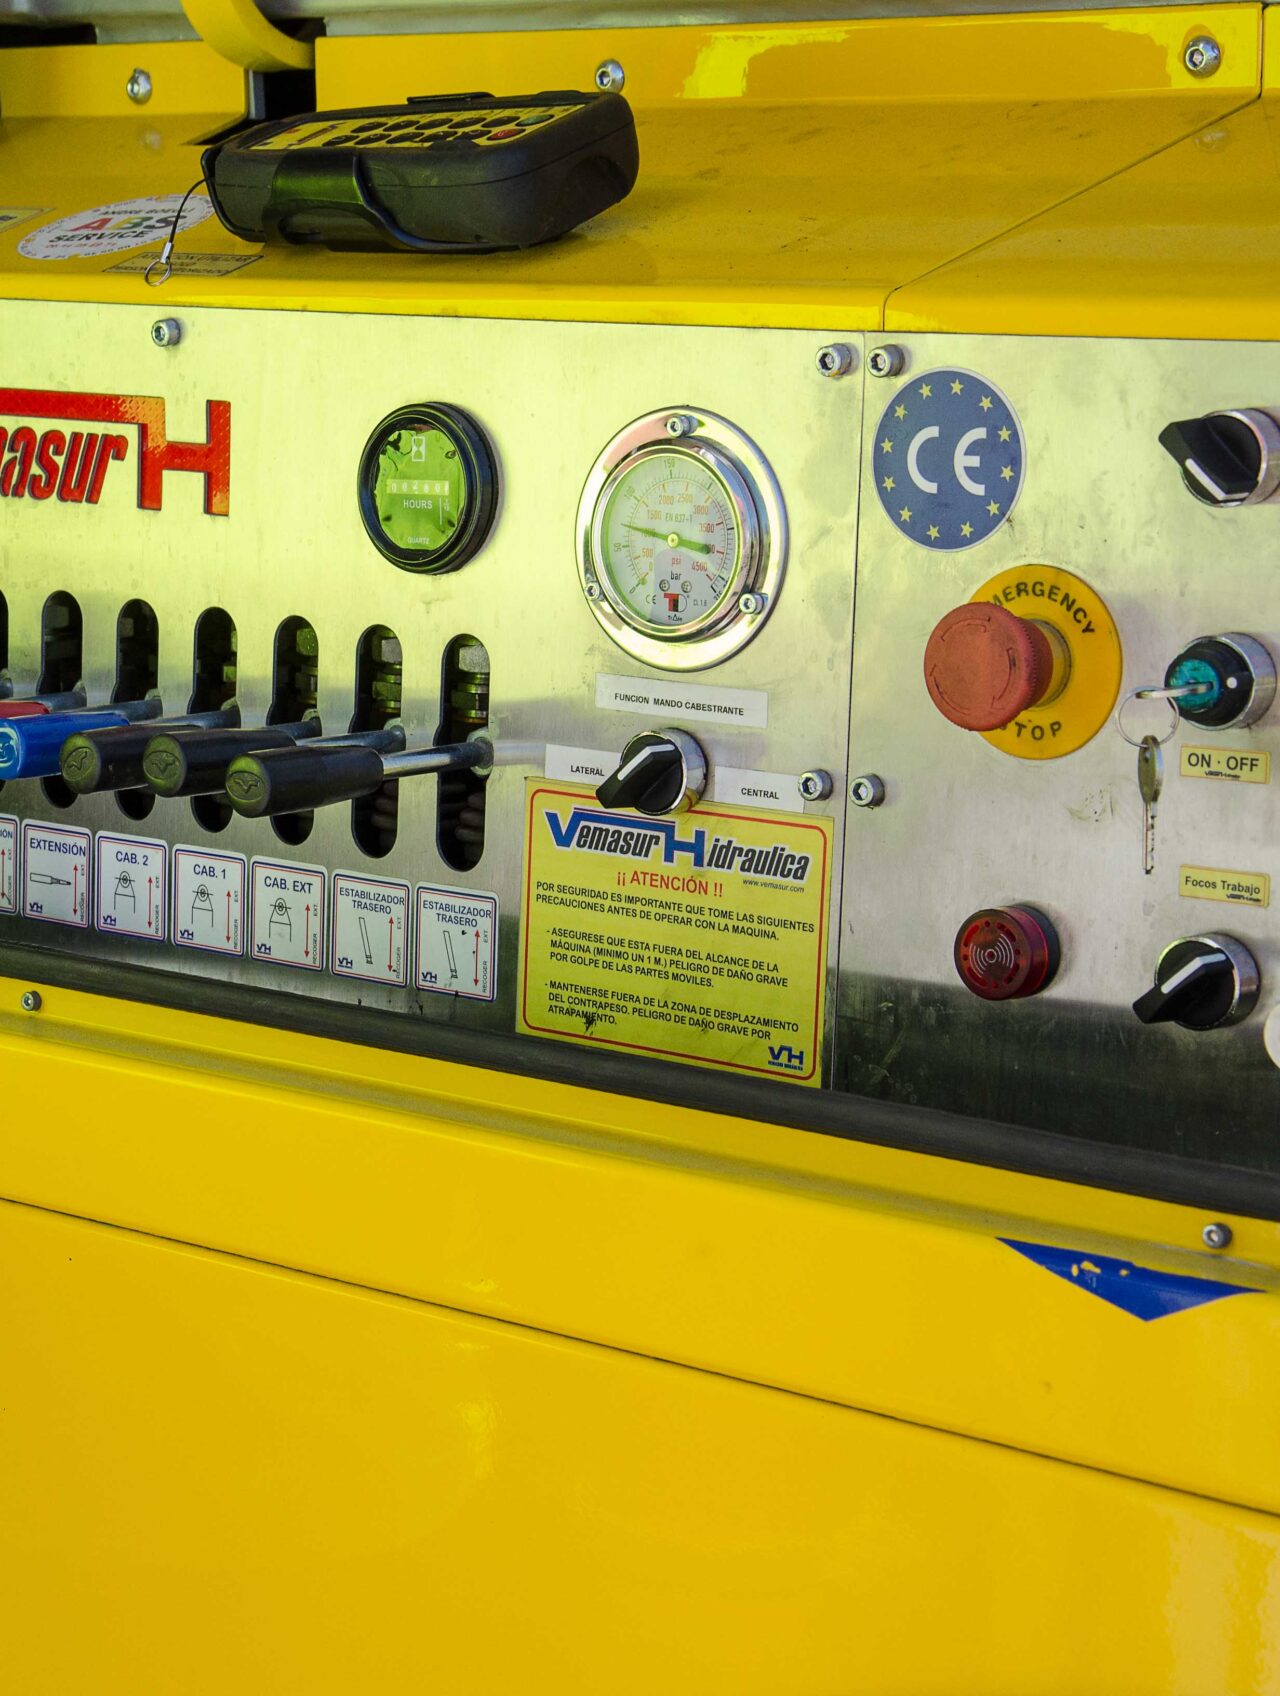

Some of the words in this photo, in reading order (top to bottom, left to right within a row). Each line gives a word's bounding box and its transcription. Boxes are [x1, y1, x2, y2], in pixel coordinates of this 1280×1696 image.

[69, 215, 188, 231] ABS
[48, 230, 154, 243] SERVICE
[906, 425, 988, 497] CE
[403, 498, 433, 509] HOURS
[670, 570, 682, 580] bar
[990, 580, 1096, 635] MERGENCY
[614, 692, 650, 706] FUNCION
[652, 697, 684, 710] MANDO
[684, 700, 745, 717] CABESTRANTE
[570, 764, 606, 778] LATERAL
[1187, 752, 1212, 769] ON
[1226, 755, 1260, 773] OFF
[740, 787, 780, 801] CENTRAL
[29, 837, 86, 857] EXTENSIÓN
[115, 850, 140, 865] CAB.
[142, 854, 149, 866] 2
[193, 863, 218, 879] CAB.
[221, 868, 227, 880] 1
[264, 875, 290, 891] CAB.
[292, 880, 313, 894] EXT
[630, 870, 709, 896] ATENCIÓN
[742, 879, 805, 894] www.vemasur.com
[1184, 875, 1218, 889] Focos
[1220, 879, 1261, 897] Trabajo
[339, 886, 405, 907] ESTABILIZADOR
[352, 899, 392, 915] TRASERO
[536, 881, 555, 892] POR
[556, 883, 609, 901] SEGURIDAD
[610, 892, 623, 903] ES
[624, 895, 684, 913] IMPORTANTE
[685, 904, 706, 916] QUE
[707, 907, 735, 921] TOME
[736, 912, 755, 924] LAS
[756, 915, 815, 933] SIGUIENTES
[422, 899, 492, 919] ESTABILIZADOR
[535, 893, 606, 913] PRECAUCIONES
[606, 905, 638, 918] ANTES
[639, 909, 652, 920] DE
[653, 912, 693, 927] OPERAR
[694, 918, 716, 931] CON
[717, 922, 730, 933] LA
[731, 924, 780, 941] MAQUINA.
[436, 912, 478, 928] TRASERO
[551, 927, 605, 944] ASEGURESE
[606, 936, 626, 948] QUE
[627, 939, 651, 952] ESTA
[652, 943, 684, 957] FUERA
[685, 949, 704, 961] DEL
[705, 952, 750, 969] ALCANCE
[751, 960, 765, 971] DE
[766, 961, 780, 973] LA
[549, 951, 569, 963] POR
[569, 954, 600, 969] GOLPE
[601, 960, 614, 971] DE
[615, 962, 633, 974] LAS
[634, 965, 670, 980] PARTES
[671, 972, 714, 988] MOVILES.
[593, 946, 630, 961] (MINIMO
[631, 952, 645, 963] UN
[646, 955, 652, 965] 1
[653, 956, 668, 969] M.)
[669, 959, 710, 975] PELIGRO
[711, 966, 725, 977] DE
[726, 968, 754, 982] DAÑO
[755, 974, 789, 988] GRAVE
[547, 1004, 618, 1025] ATRAPAMIENTO.
[548, 992, 566, 1003] DEL
[567, 995, 630, 1016] CONTRAPESO.
[631, 1006, 672, 1022] PELIGRO
[673, 1014, 687, 1025] DE
[688, 1016, 716, 1030] DAÑO
[716, 1022, 749, 1037] GRAVE
[750, 1028, 771, 1040] POR
[549, 979, 609, 999] MANTENERSE
[610, 991, 642, 1005] FUERA
[642, 996, 656, 1007] DE
[657, 998, 670, 1009] LA
[670, 1001, 697, 1015] ZONA
[698, 1006, 712, 1017] DE
[713, 1008, 799, 1033] DESPLAZAMIENTO
